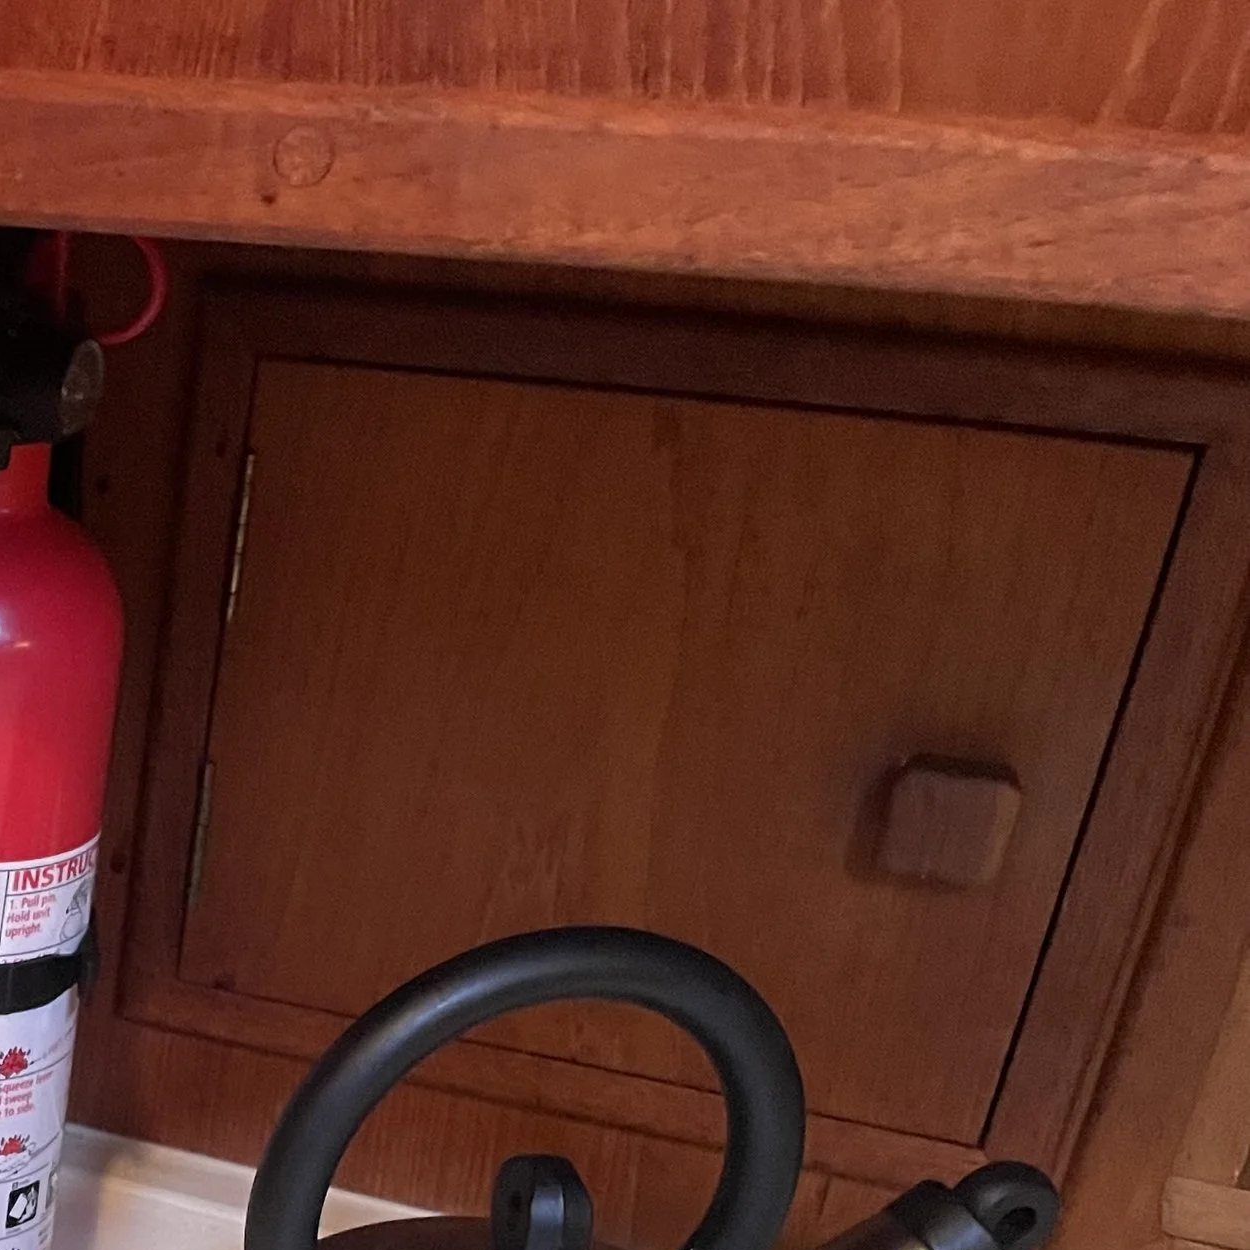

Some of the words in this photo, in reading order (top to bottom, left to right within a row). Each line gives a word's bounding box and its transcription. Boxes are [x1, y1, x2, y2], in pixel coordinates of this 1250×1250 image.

[22, 894, 40, 909] Pull
[6, 911, 31, 924] Hold
[33, 907, 51, 920] unit
[4, 1091, 33, 1106] sweep
[4, 1107, 15, 1117] to
